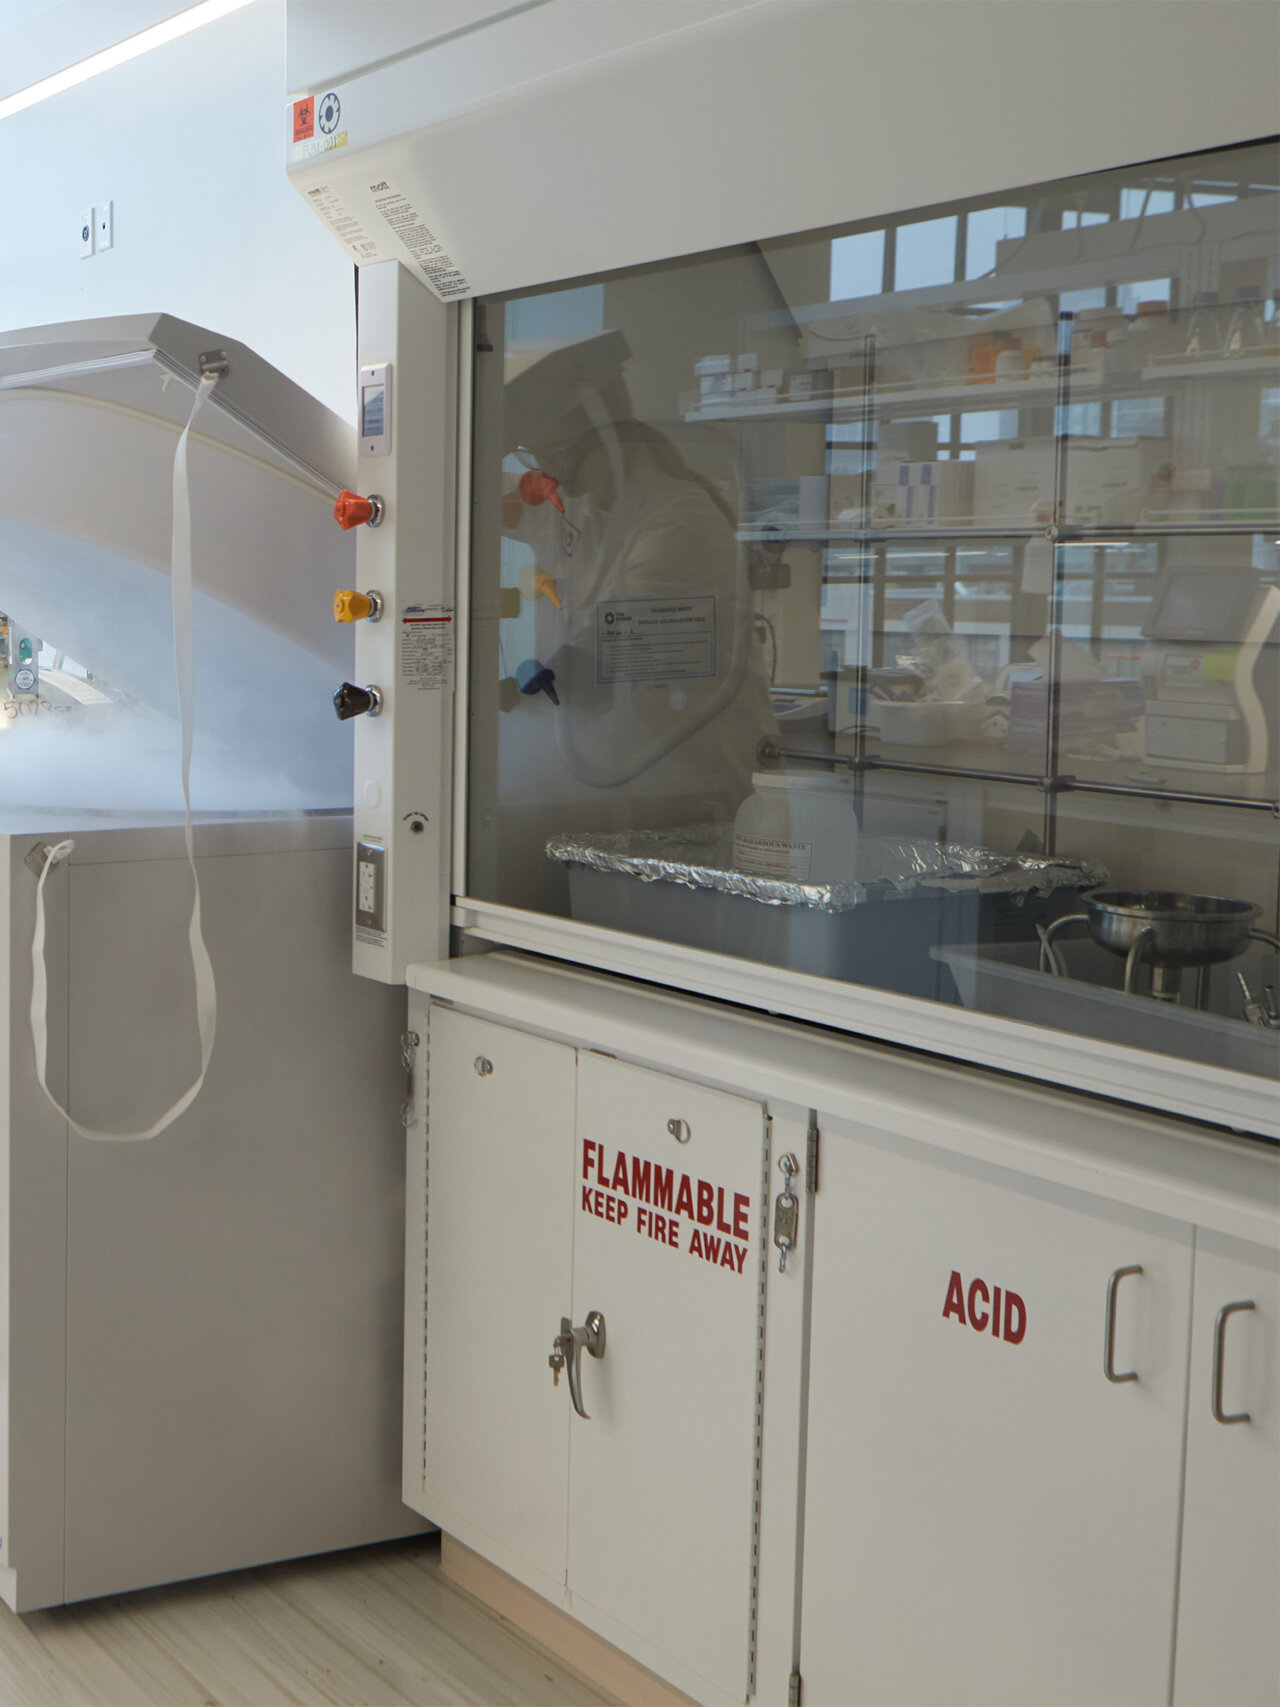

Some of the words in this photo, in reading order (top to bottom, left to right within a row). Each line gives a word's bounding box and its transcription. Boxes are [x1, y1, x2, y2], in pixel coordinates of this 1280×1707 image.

[369, 180, 391, 193] mott
[581, 1186, 629, 1226] KEEP
[636, 1207, 681, 1249] FIRE
[688, 1229, 749, 1275] AWAY
[582, 1139, 751, 1242] FLAMMABLE
[942, 1270, 1028, 1346] ACID
